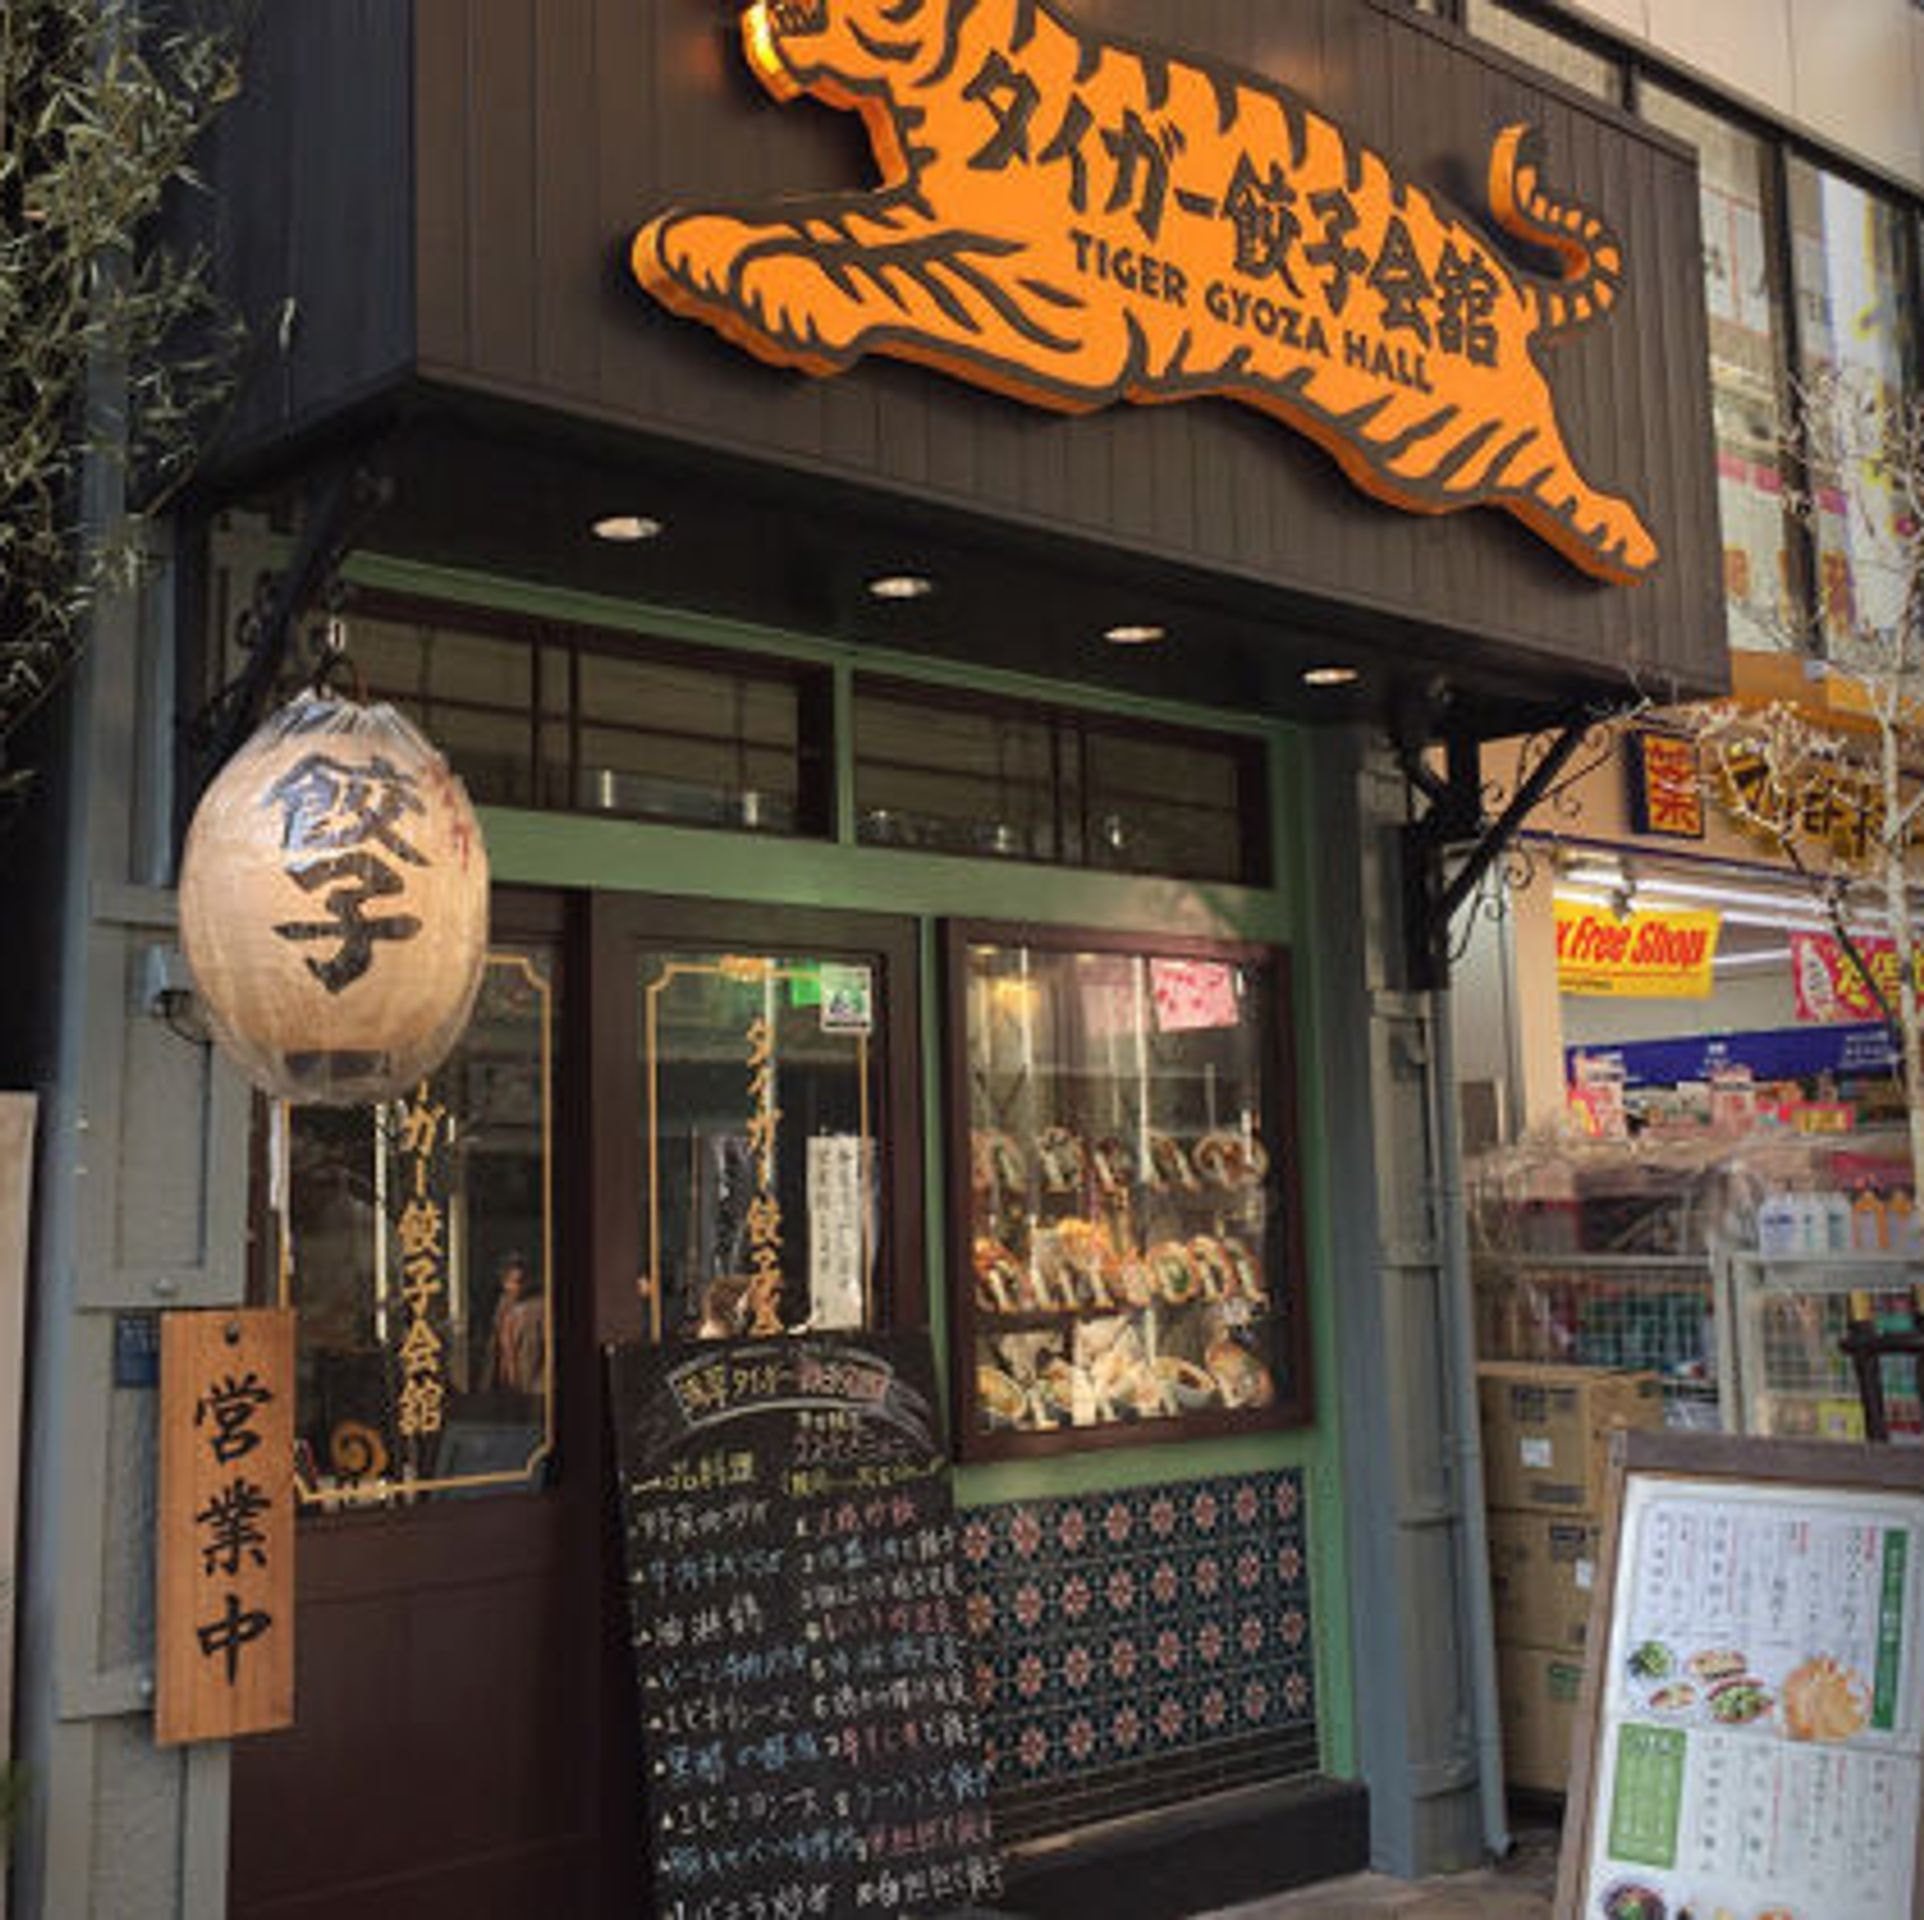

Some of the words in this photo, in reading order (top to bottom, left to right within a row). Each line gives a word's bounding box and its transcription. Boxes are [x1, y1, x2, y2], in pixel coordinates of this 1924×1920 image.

[962, 49, 1499, 368] タイガー餃子会館
[1069, 228, 1188, 308] TIGER
[1204, 280, 1330, 358] GYOZA
[1343, 329, 1433, 394] HALL
[262, 753, 431, 995] 餃子
[1629, 920, 1709, 970] Shop
[194, 1372, 273, 1687] 営業中
